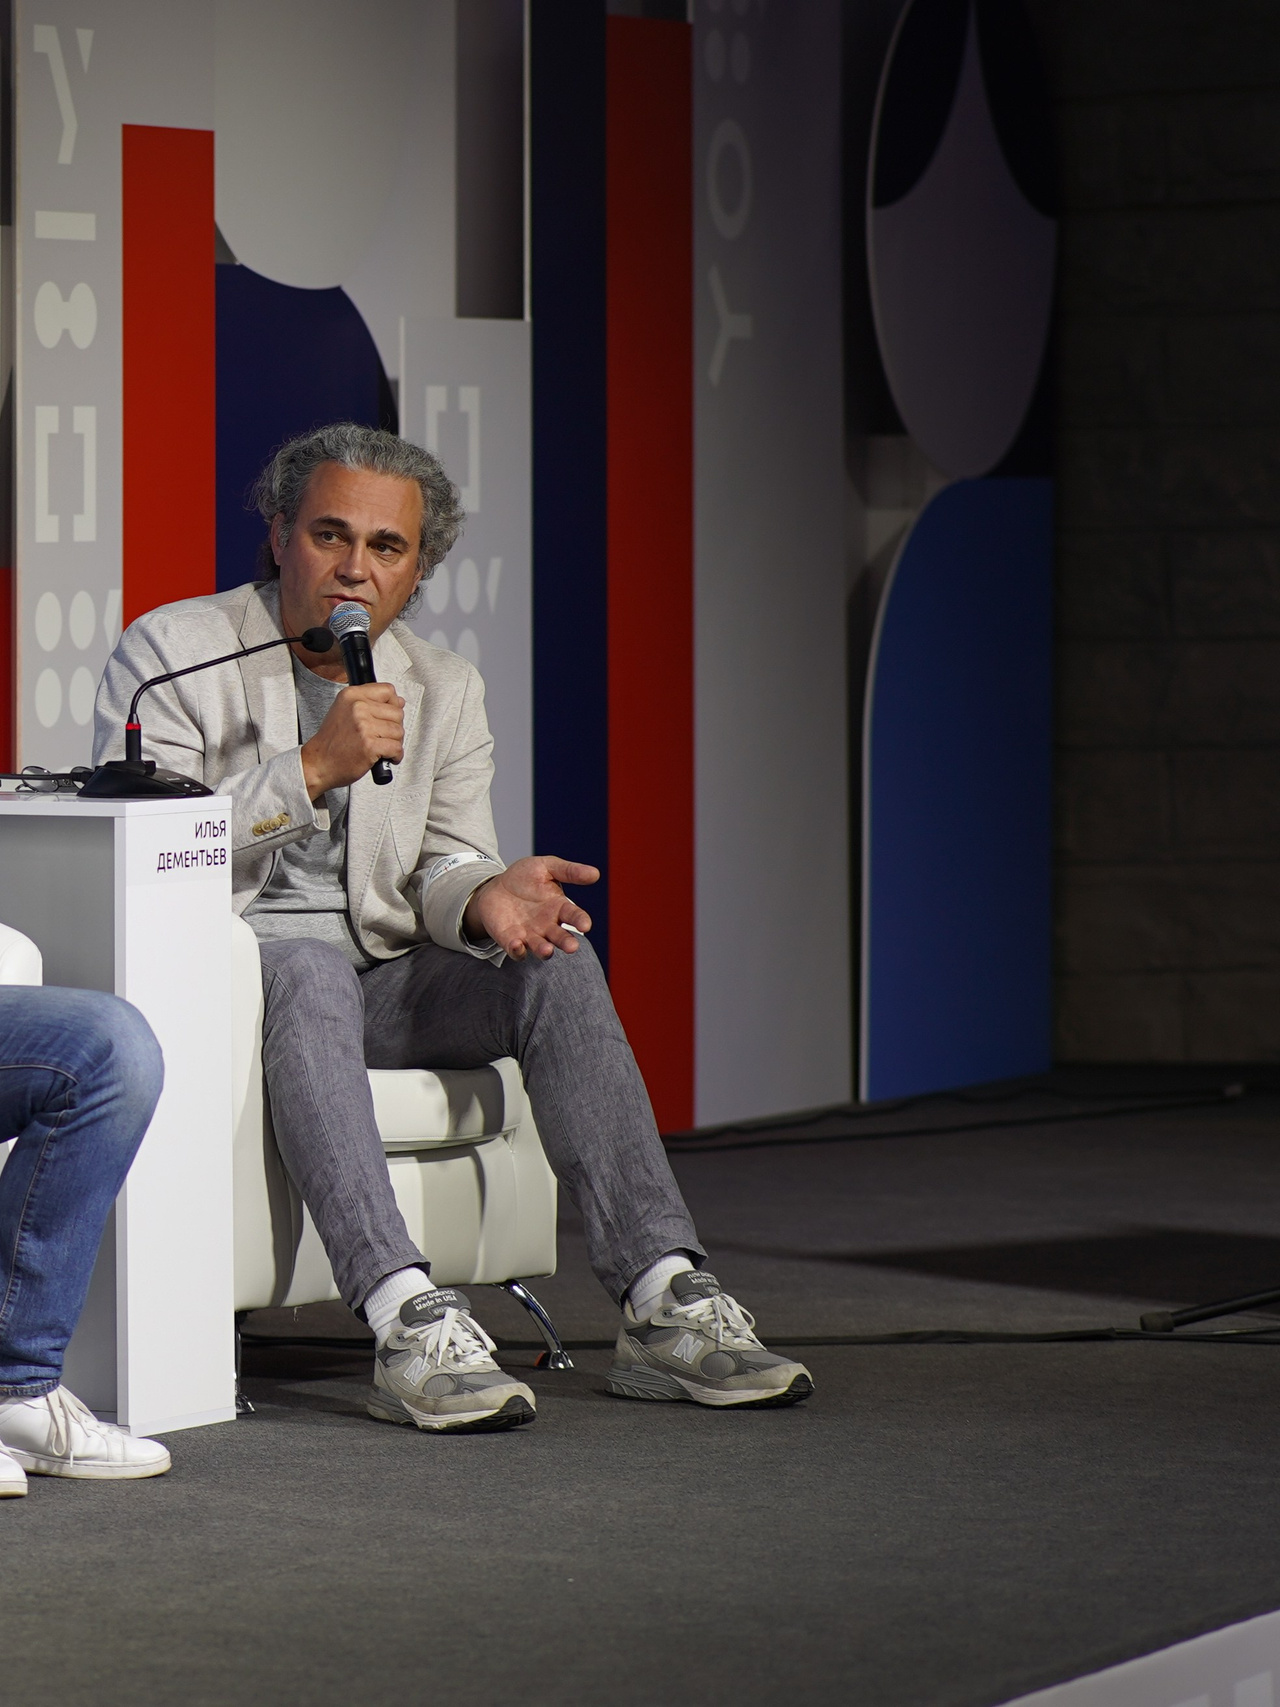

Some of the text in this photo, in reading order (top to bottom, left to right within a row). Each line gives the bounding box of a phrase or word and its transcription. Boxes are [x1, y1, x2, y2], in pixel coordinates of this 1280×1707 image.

[195, 820, 226, 839] ИЛЬЯ
[157, 848, 227, 873] ДЕМЕНТЬЕВ
[412, 1295, 428, 1305] new
[415, 1300, 435, 1312] Made
[672, 1333, 705, 1365] N
[403, 1355, 432, 1387] N
